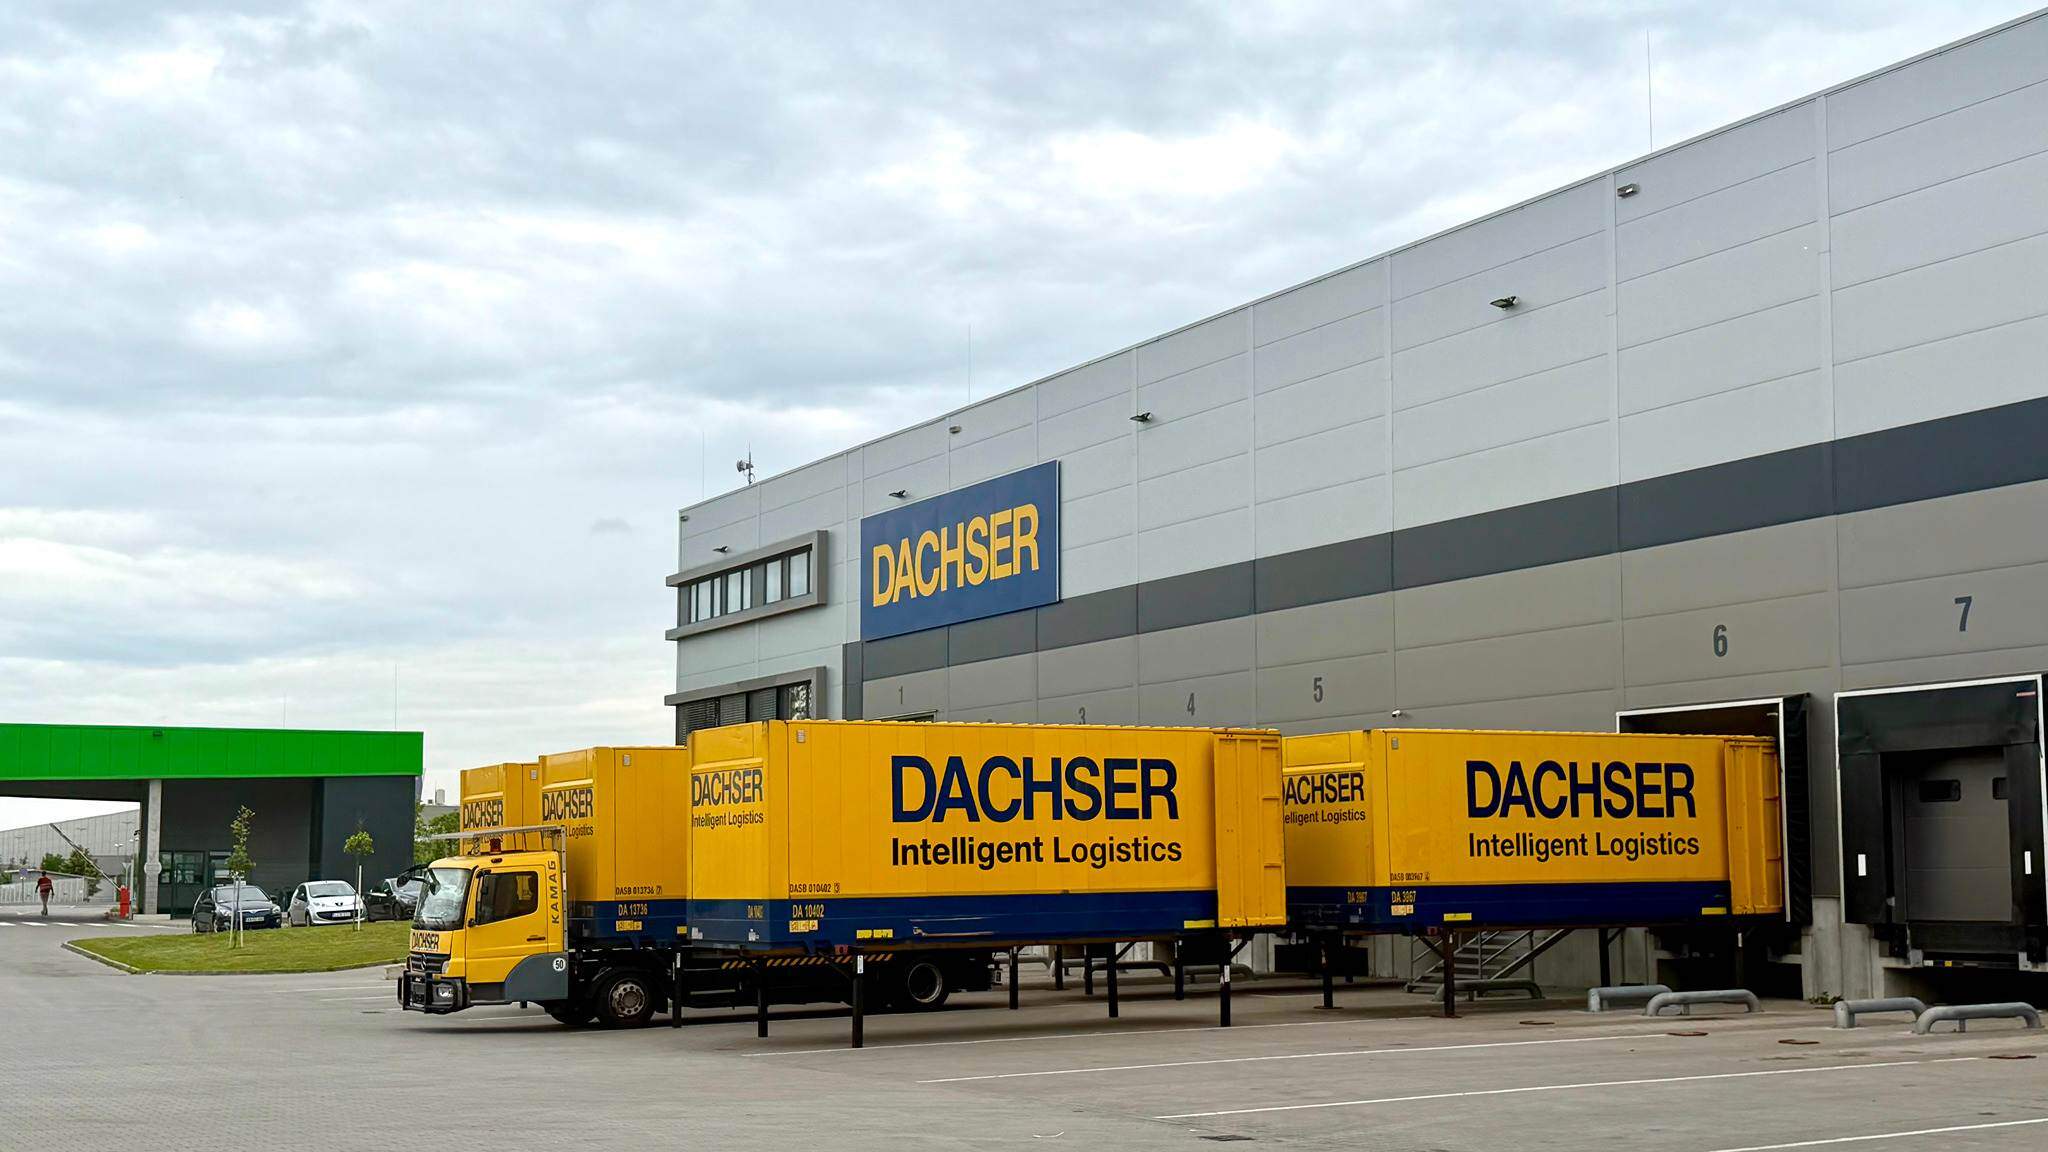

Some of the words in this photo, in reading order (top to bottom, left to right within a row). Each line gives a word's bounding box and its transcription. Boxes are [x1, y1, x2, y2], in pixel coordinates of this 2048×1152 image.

[873, 503, 1039, 607] DACHSER
[1954, 596, 1972, 632] 7
[1713, 624, 1728, 657] 6
[899, 686, 903, 704] 1
[1313, 677, 1323, 703] 5
[1078, 707, 1086, 724] 3
[1187, 692, 1195, 716] 4
[692, 769, 763, 806] DACHSER
[891, 755, 1178, 823] DACHSER
[1466, 760, 1696, 819] DACHSER
[463, 800, 503, 828] DACHSER
[542, 788, 593, 821] DACHSER
[692, 812, 726, 830] Intelligent
[729, 810, 763, 828] Logistics
[1284, 810, 1319, 826] elligent
[1321, 809, 1366, 824] Logistics
[568, 824, 593, 839] Logistics
[892, 836, 1043, 870] Intelligent
[1053, 836, 1182, 869] Logistics
[1469, 832, 1588, 863] Intelligent
[1596, 831, 1699, 862] Logistics
[548, 860, 559, 924] KAMAG
[616, 886, 631, 895] DASB
[790, 884, 806, 893] DASB
[808, 884, 831, 893] 010402
[1391, 891, 1401, 903] DA
[618, 904, 628, 916] DA
[630, 904, 648, 915] 13736
[792, 905, 803, 918] DA
[805, 904, 824, 918] 10402
[412, 933, 439, 949] DACHSER
[555, 960, 564, 969] 50
